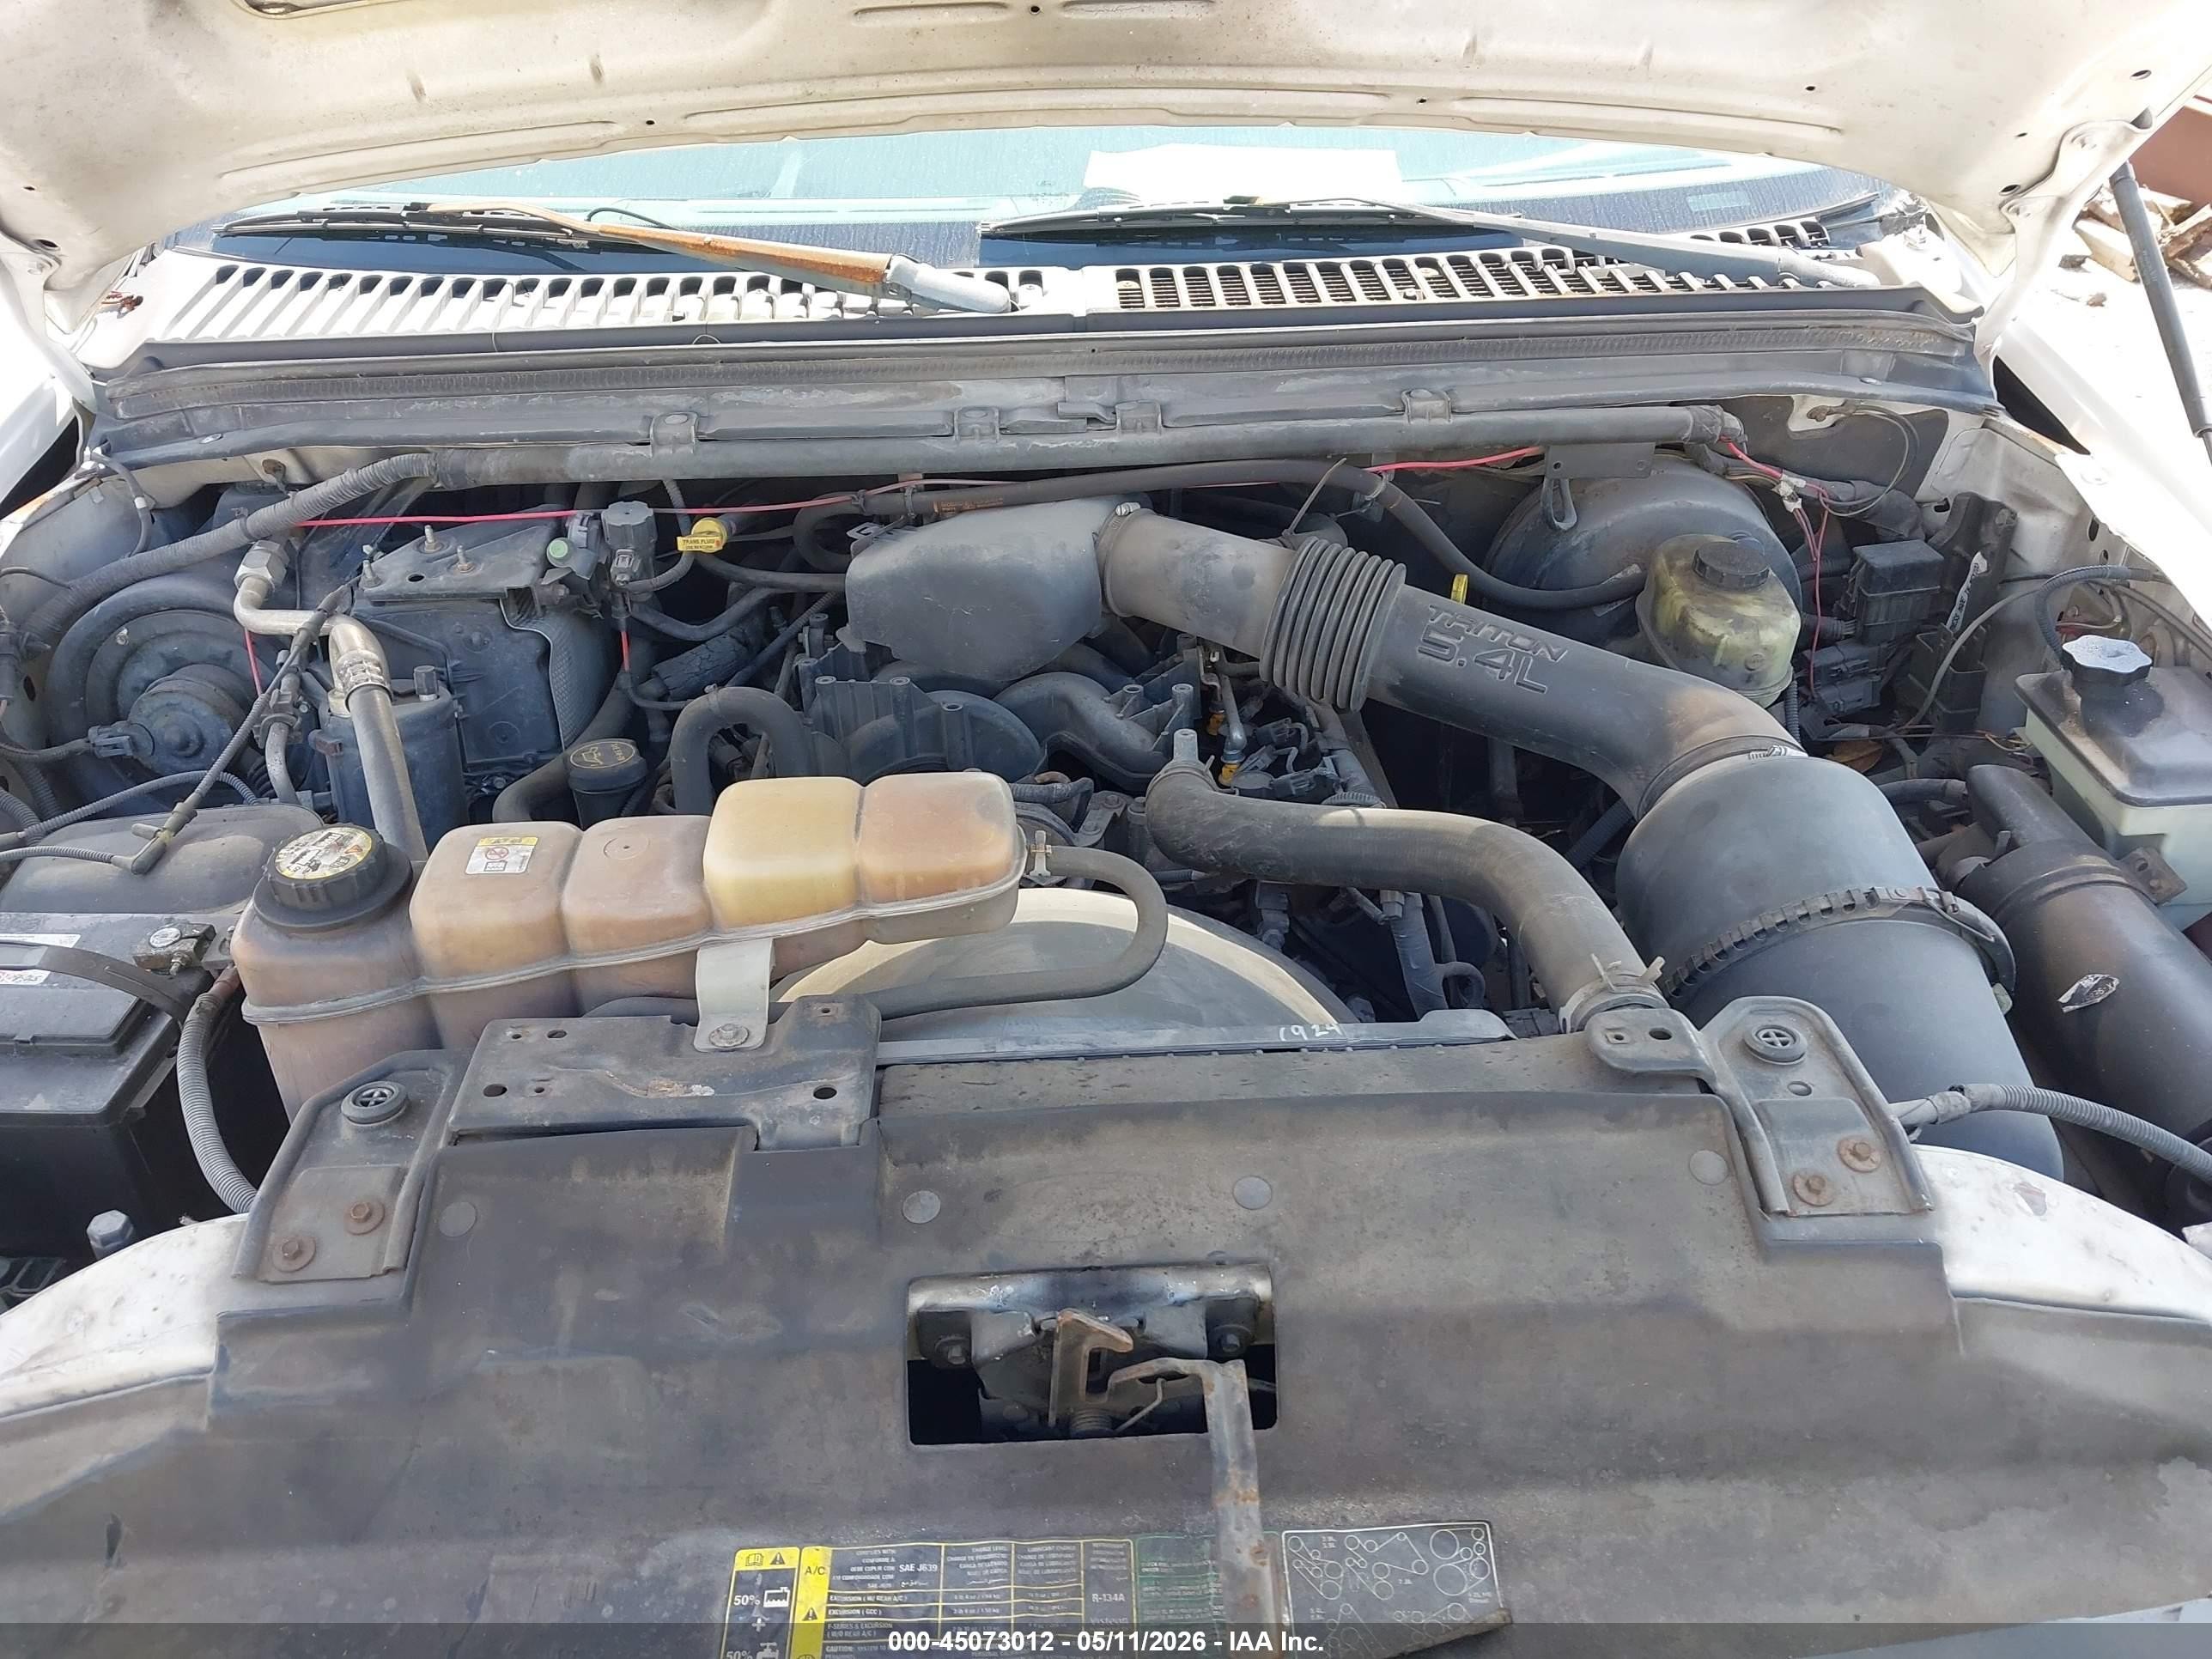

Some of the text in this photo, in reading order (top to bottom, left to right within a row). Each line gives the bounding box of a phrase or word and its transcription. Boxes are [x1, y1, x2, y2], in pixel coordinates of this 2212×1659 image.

[1428, 604, 1569, 663] TRITON
[1417, 622, 1548, 695] 5.4L
[804, 1566, 826, 1577] A/C
[899, 1563, 938, 1573] SAE J639
[733, 1595, 761, 1607] 50%
[1091, 1593, 1126, 1602] R-134A
[726, 1650, 753, 1659] 50%
